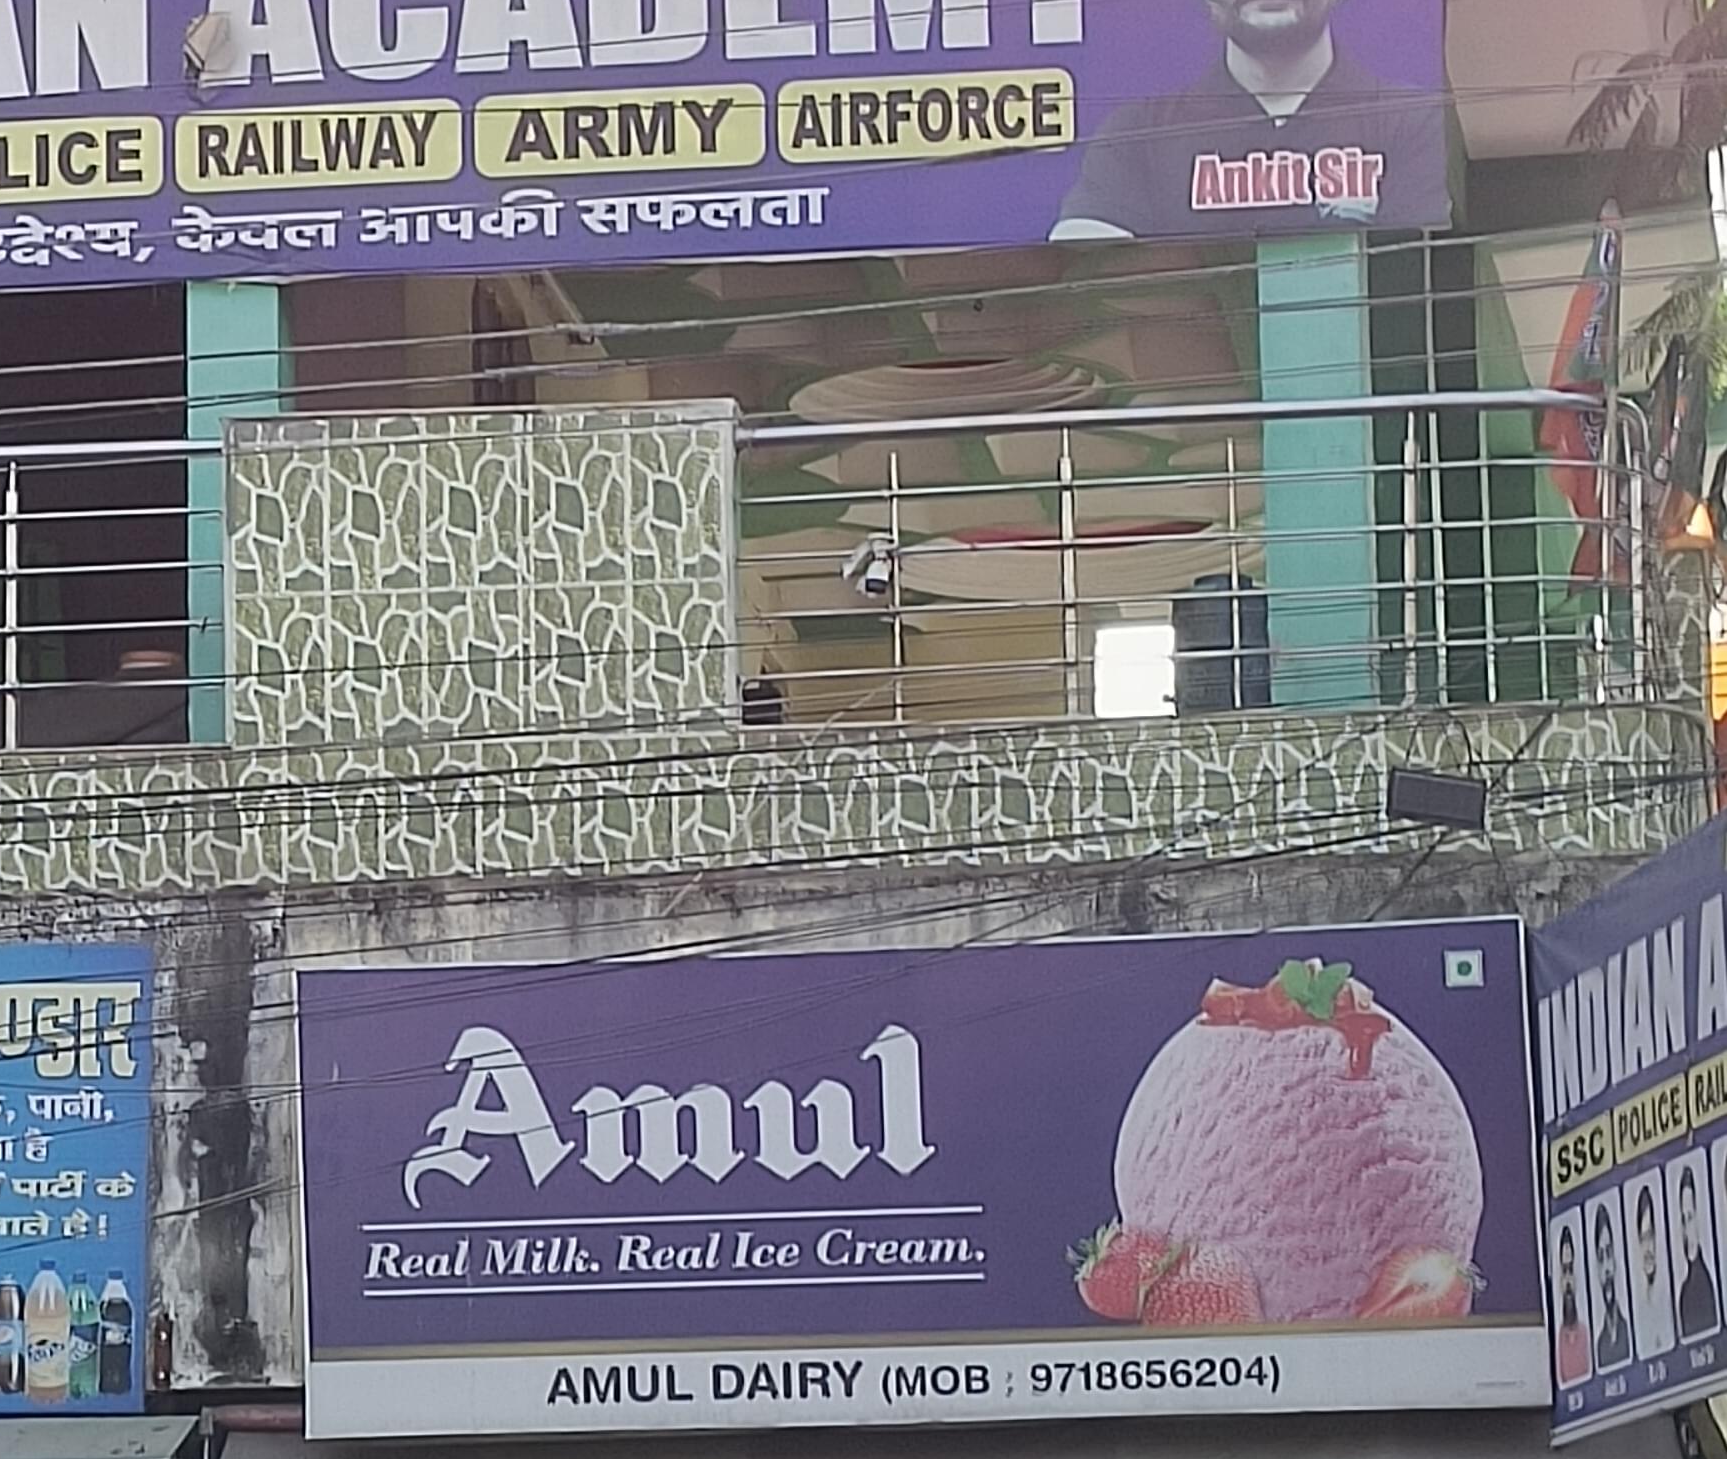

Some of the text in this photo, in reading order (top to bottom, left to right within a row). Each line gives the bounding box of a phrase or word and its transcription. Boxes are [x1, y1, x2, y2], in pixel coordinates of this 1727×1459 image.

[195, 113, 432, 178] RAILWAY
[504, 97, 735, 164] ARMY
[791, 80, 1062, 149] AIRFORCE
[1191, 147, 1383, 210] Ankit Sir
[358, 188, 564, 246] आपकी
[576, 186, 830, 235] सफलता
[1537, 918, 1687, 1124] INDIAN
[401, 1024, 937, 1209] Amul
[1618, 1086, 1683, 1154] POLICE
[94, 1170, 137, 1198] के
[1556, 1125, 1606, 1188] SSC
[365, 1227, 986, 1282] Real Milk. Real Ice Cream.
[546, 1364, 694, 1404] AMUL
[712, 1361, 864, 1400] DAIRY
[881, 1364, 990, 1404] (MOB
[1030, 1355, 1281, 1396] 9718656204)
